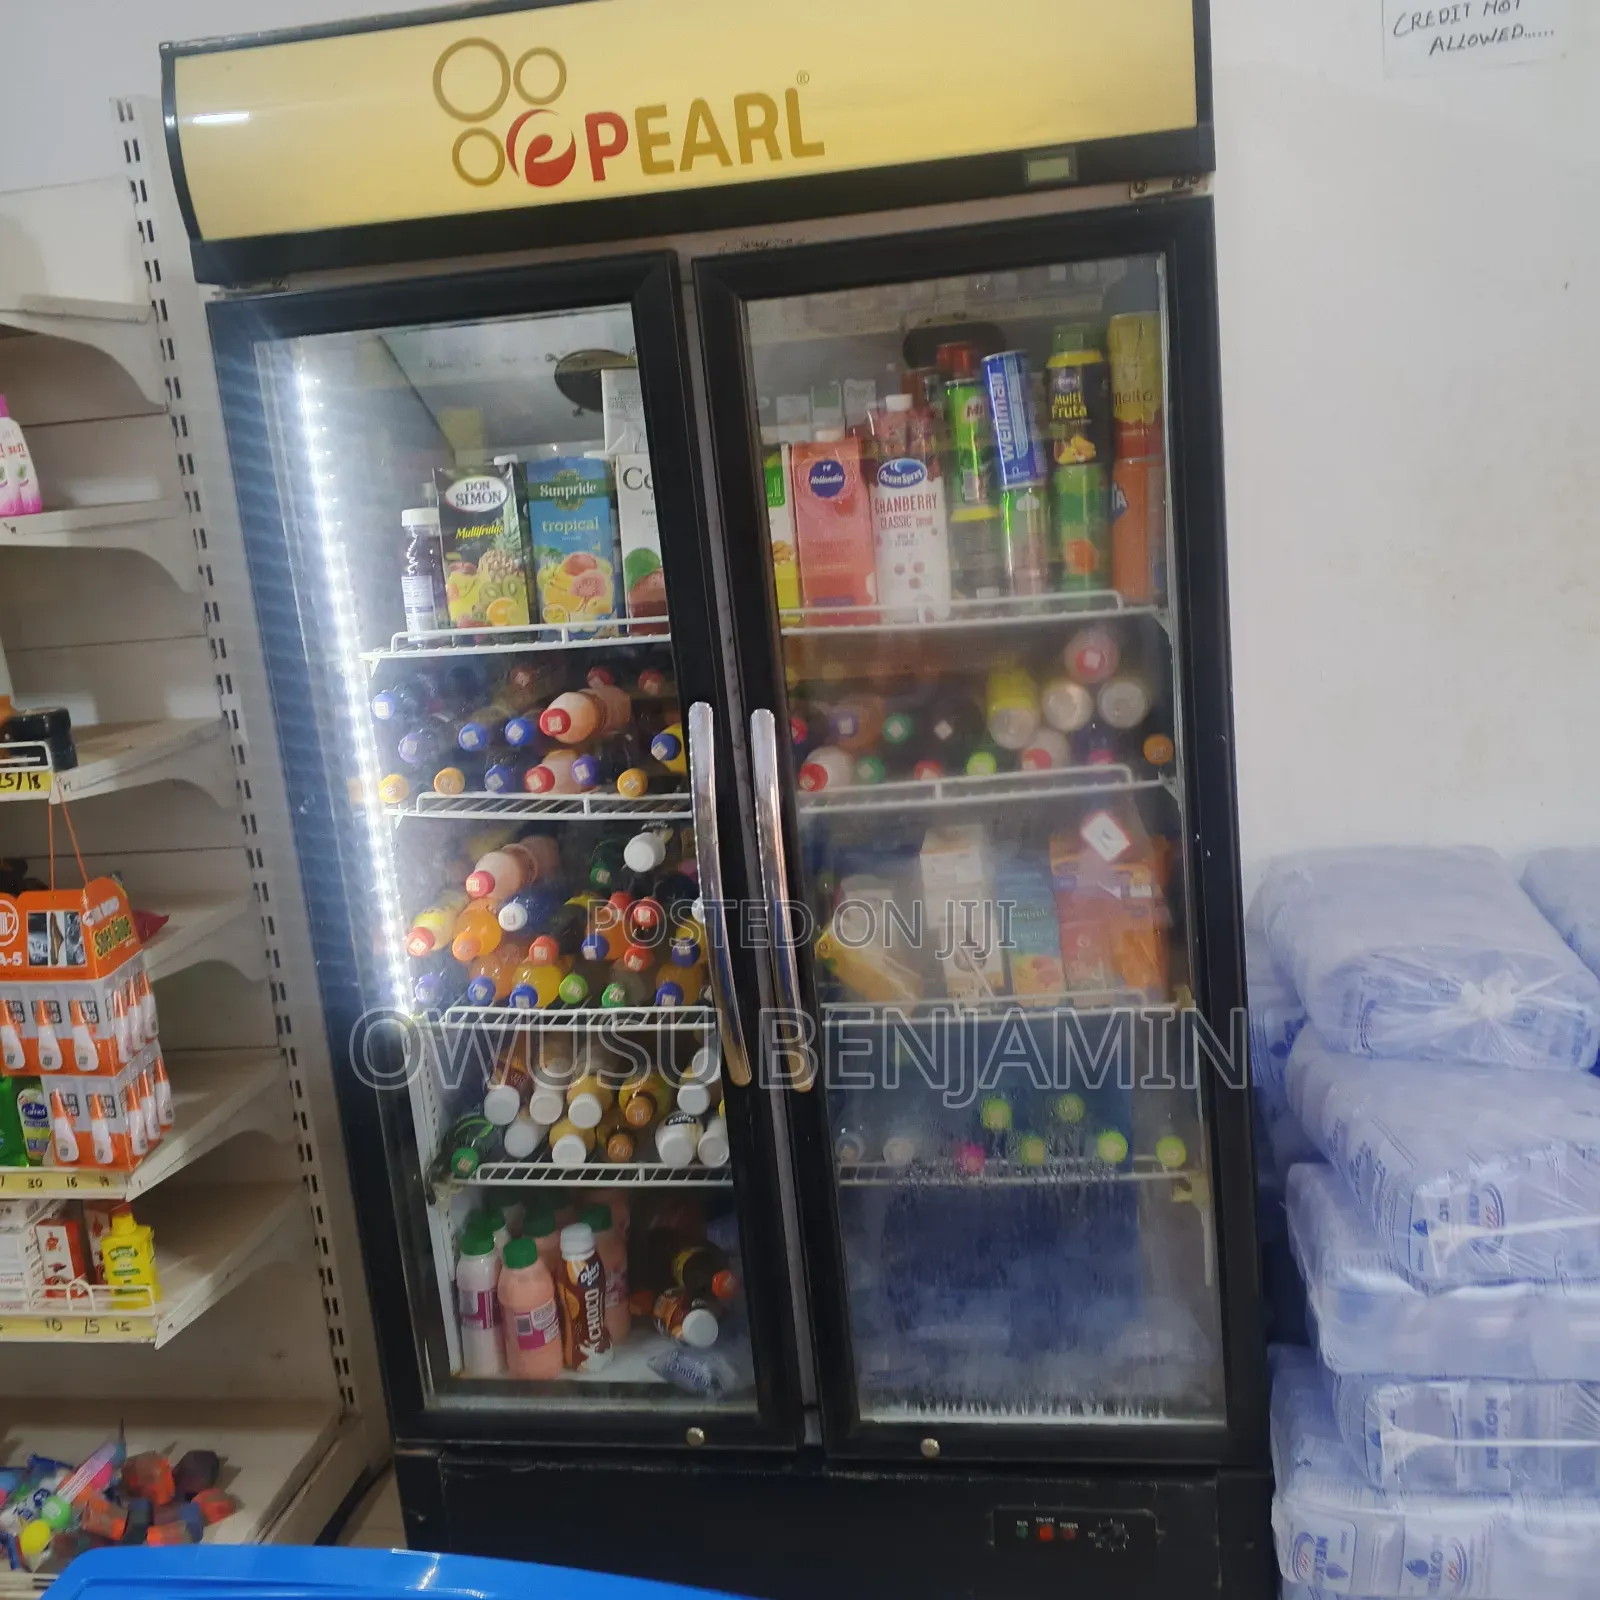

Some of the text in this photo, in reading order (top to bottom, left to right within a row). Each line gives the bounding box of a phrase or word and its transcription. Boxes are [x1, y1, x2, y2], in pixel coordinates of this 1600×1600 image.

[1393, 1, 1471, 38] CREDIT
[1054, 391, 1082, 405] Multi
[1051, 404, 1088, 419] Fruta
[465, 481, 491, 492] DON
[539, 482, 598, 500] Sunpride
[455, 490, 502, 508] SIMON
[874, 493, 937, 515] CRANBERRY
[542, 516, 599, 535] tropical
[880, 515, 912, 529] CLASSIC
[584, 1286, 602, 1341] CHOCO
